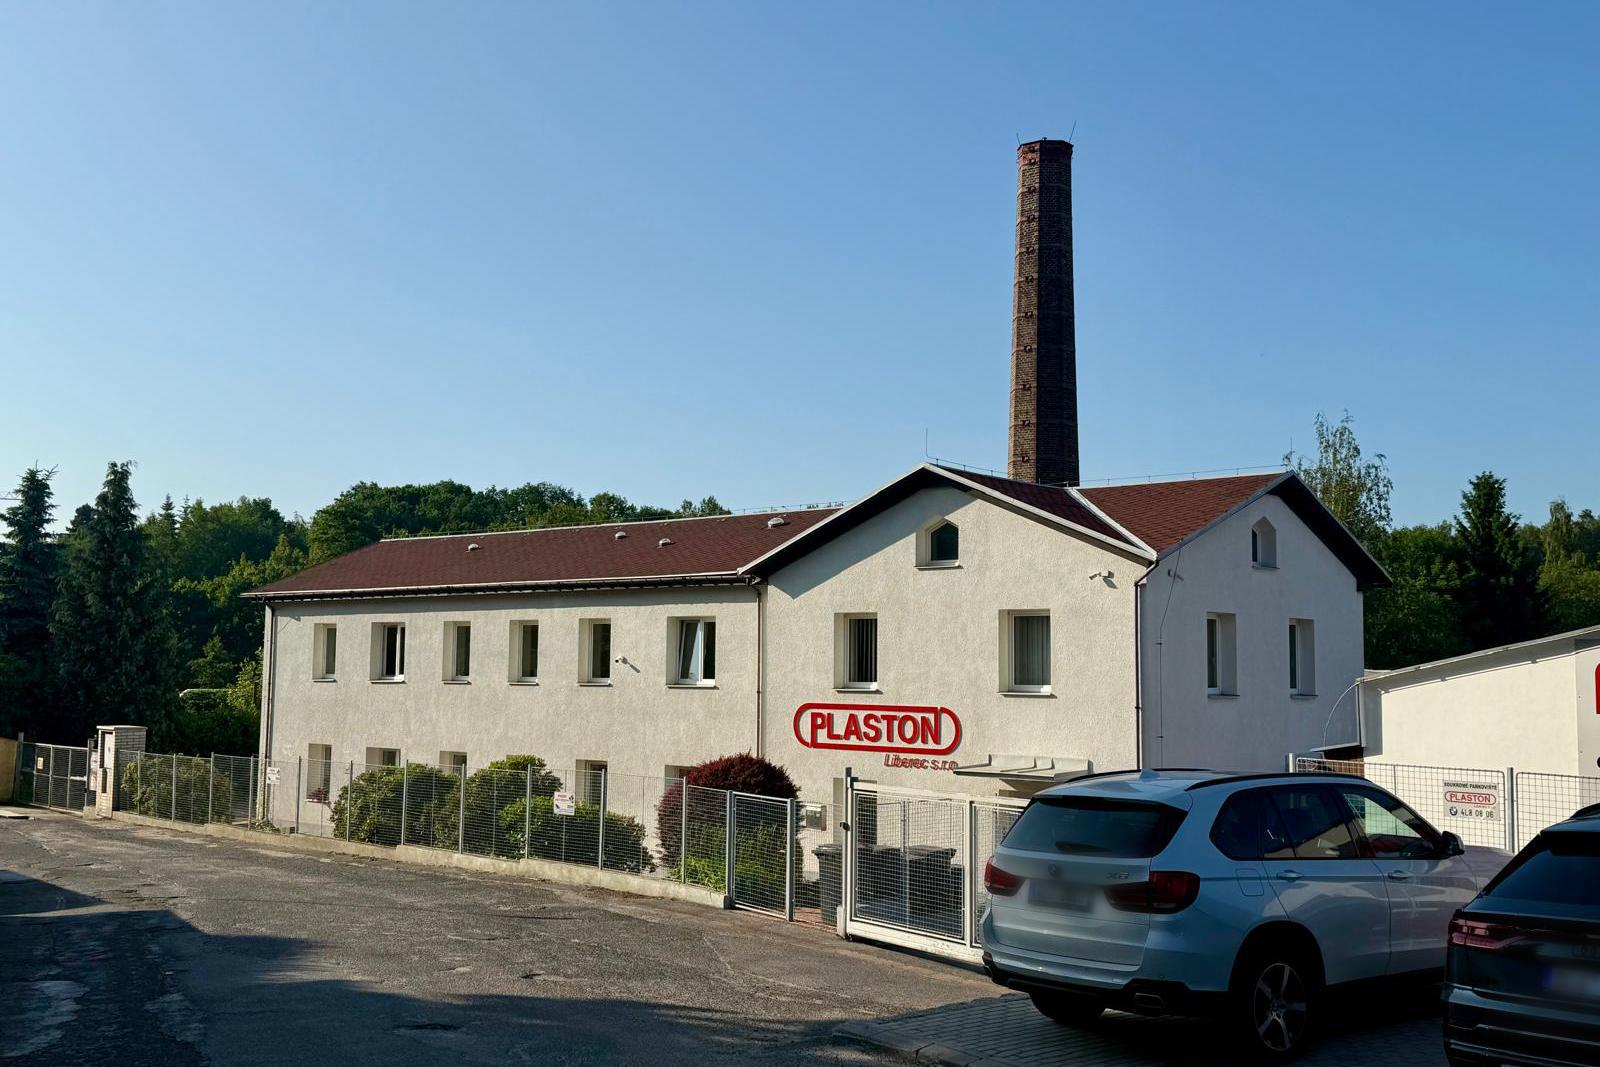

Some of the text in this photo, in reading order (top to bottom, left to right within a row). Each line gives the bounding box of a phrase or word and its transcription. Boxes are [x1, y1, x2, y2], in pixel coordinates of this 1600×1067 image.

[810, 711, 942, 746] PLASTON
[883, 754, 928, 769] Liberec
[1450, 793, 1491, 803] PLASTON
